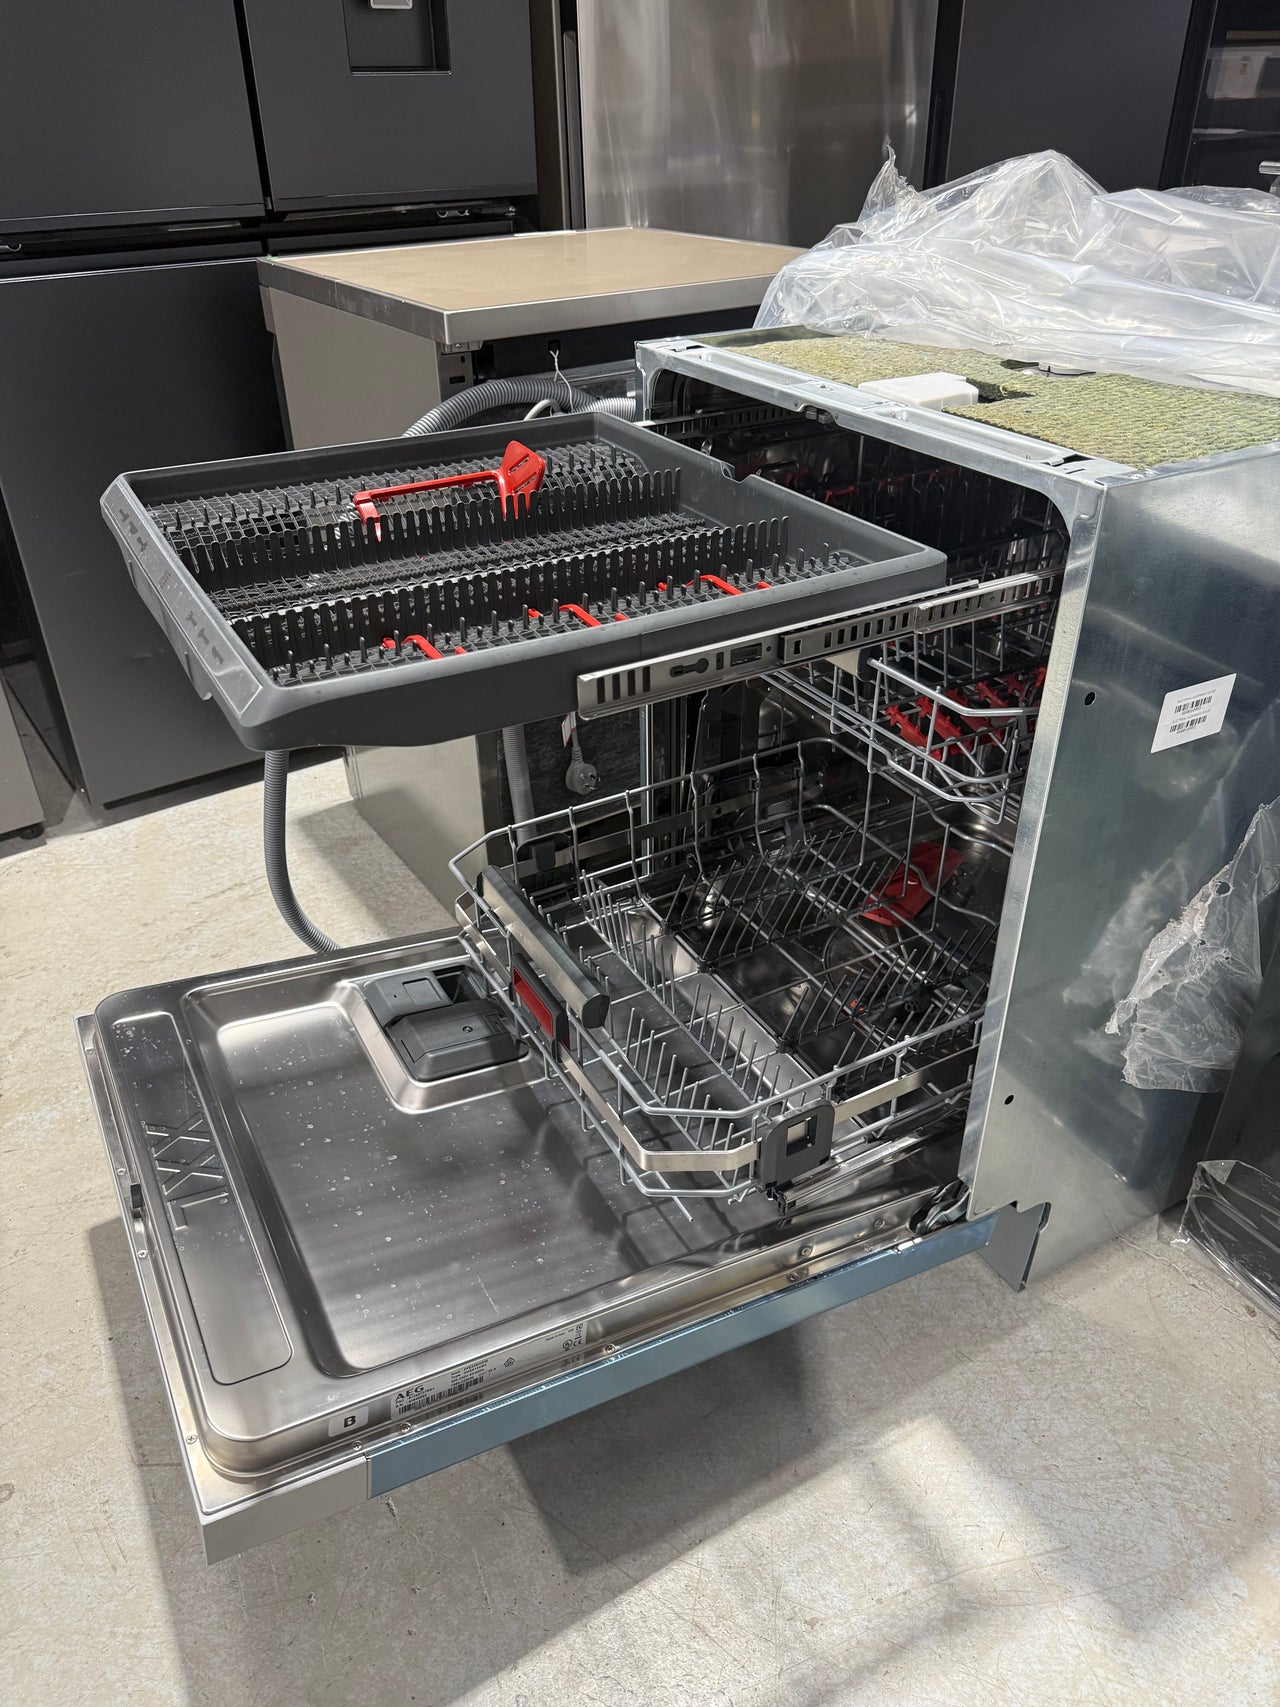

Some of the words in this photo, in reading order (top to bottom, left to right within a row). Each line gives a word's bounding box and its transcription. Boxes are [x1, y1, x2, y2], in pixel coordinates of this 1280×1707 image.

[145, 1111, 229, 1231] XXL
[394, 1385, 425, 1402] AEG
[343, 1415, 356, 1428] B
